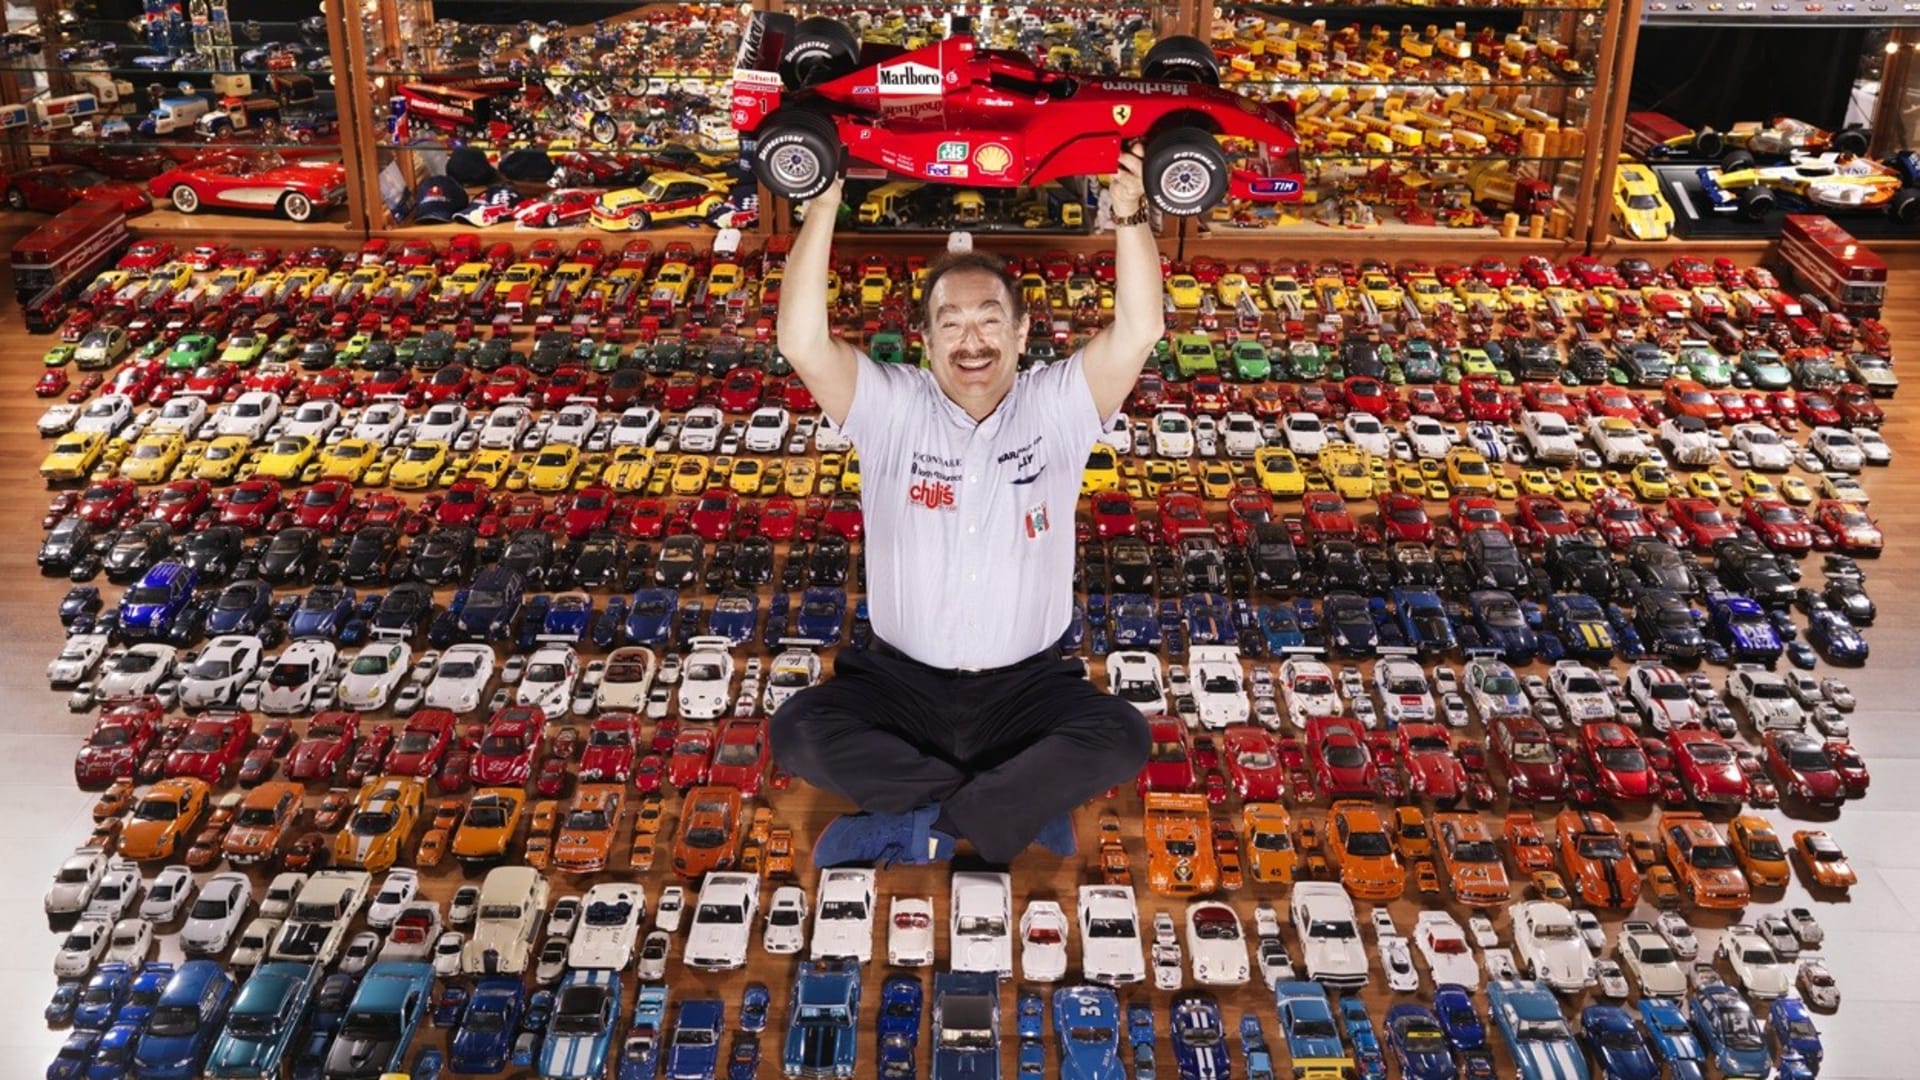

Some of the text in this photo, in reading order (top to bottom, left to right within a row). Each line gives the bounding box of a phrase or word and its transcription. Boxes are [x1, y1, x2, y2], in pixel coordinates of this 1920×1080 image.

[747, 73, 778, 83] Shell
[880, 67, 940, 85] Marlboro
[1102, 82, 1188, 96] Marlboro
[1274, 181, 1294, 191] TIM
[910, 479, 954, 509] chili's
[1271, 868, 1282, 877] 45
[1078, 996, 1101, 1017] 39
